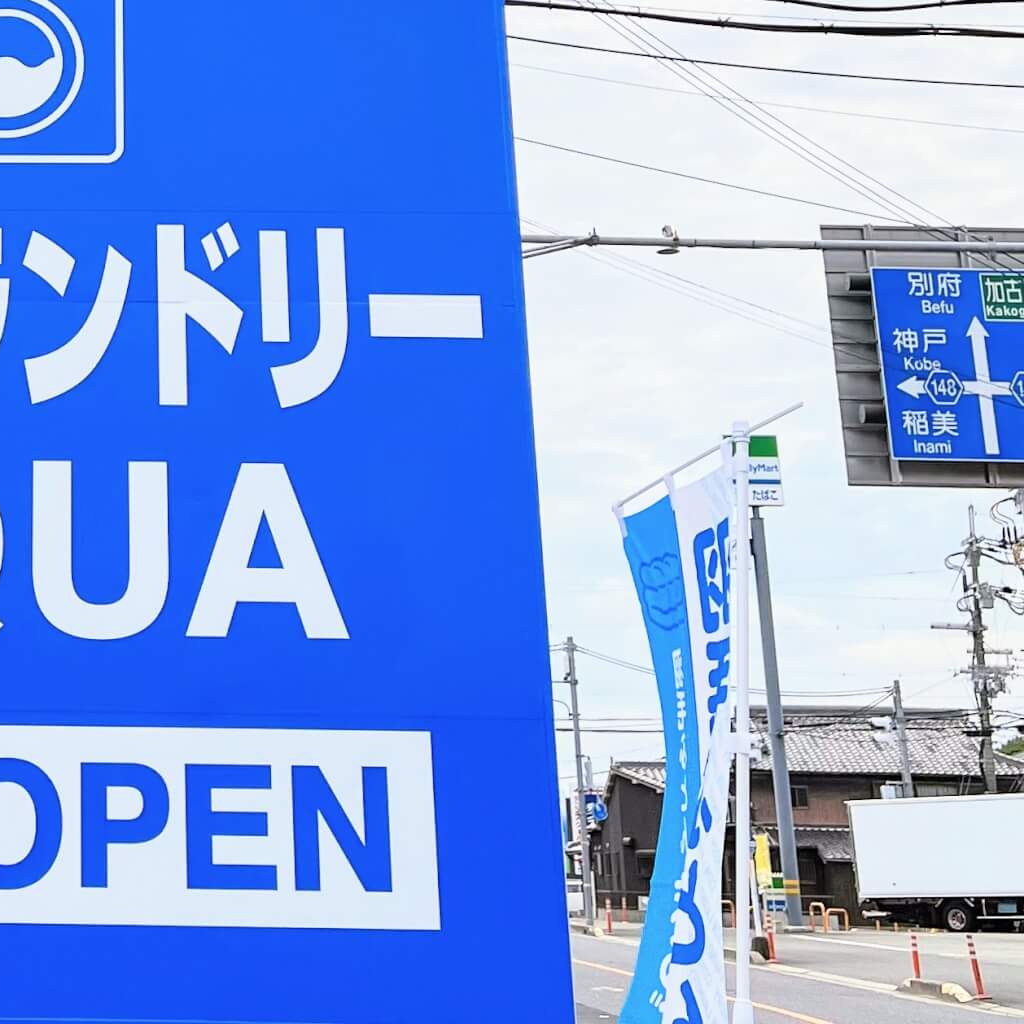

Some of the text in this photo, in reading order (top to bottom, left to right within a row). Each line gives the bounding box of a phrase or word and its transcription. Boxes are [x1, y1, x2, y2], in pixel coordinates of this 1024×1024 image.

[907, 272, 962, 297] 別府
[985, 277, 1024, 303] 加古
[921, 300, 954, 314] Befu
[893, 328, 947, 353] 神戸
[904, 357, 941, 371] Kobe
[931, 379, 957, 397] 148
[902, 410, 959, 436] 稲美
[913, 440, 952, 454] Inami
